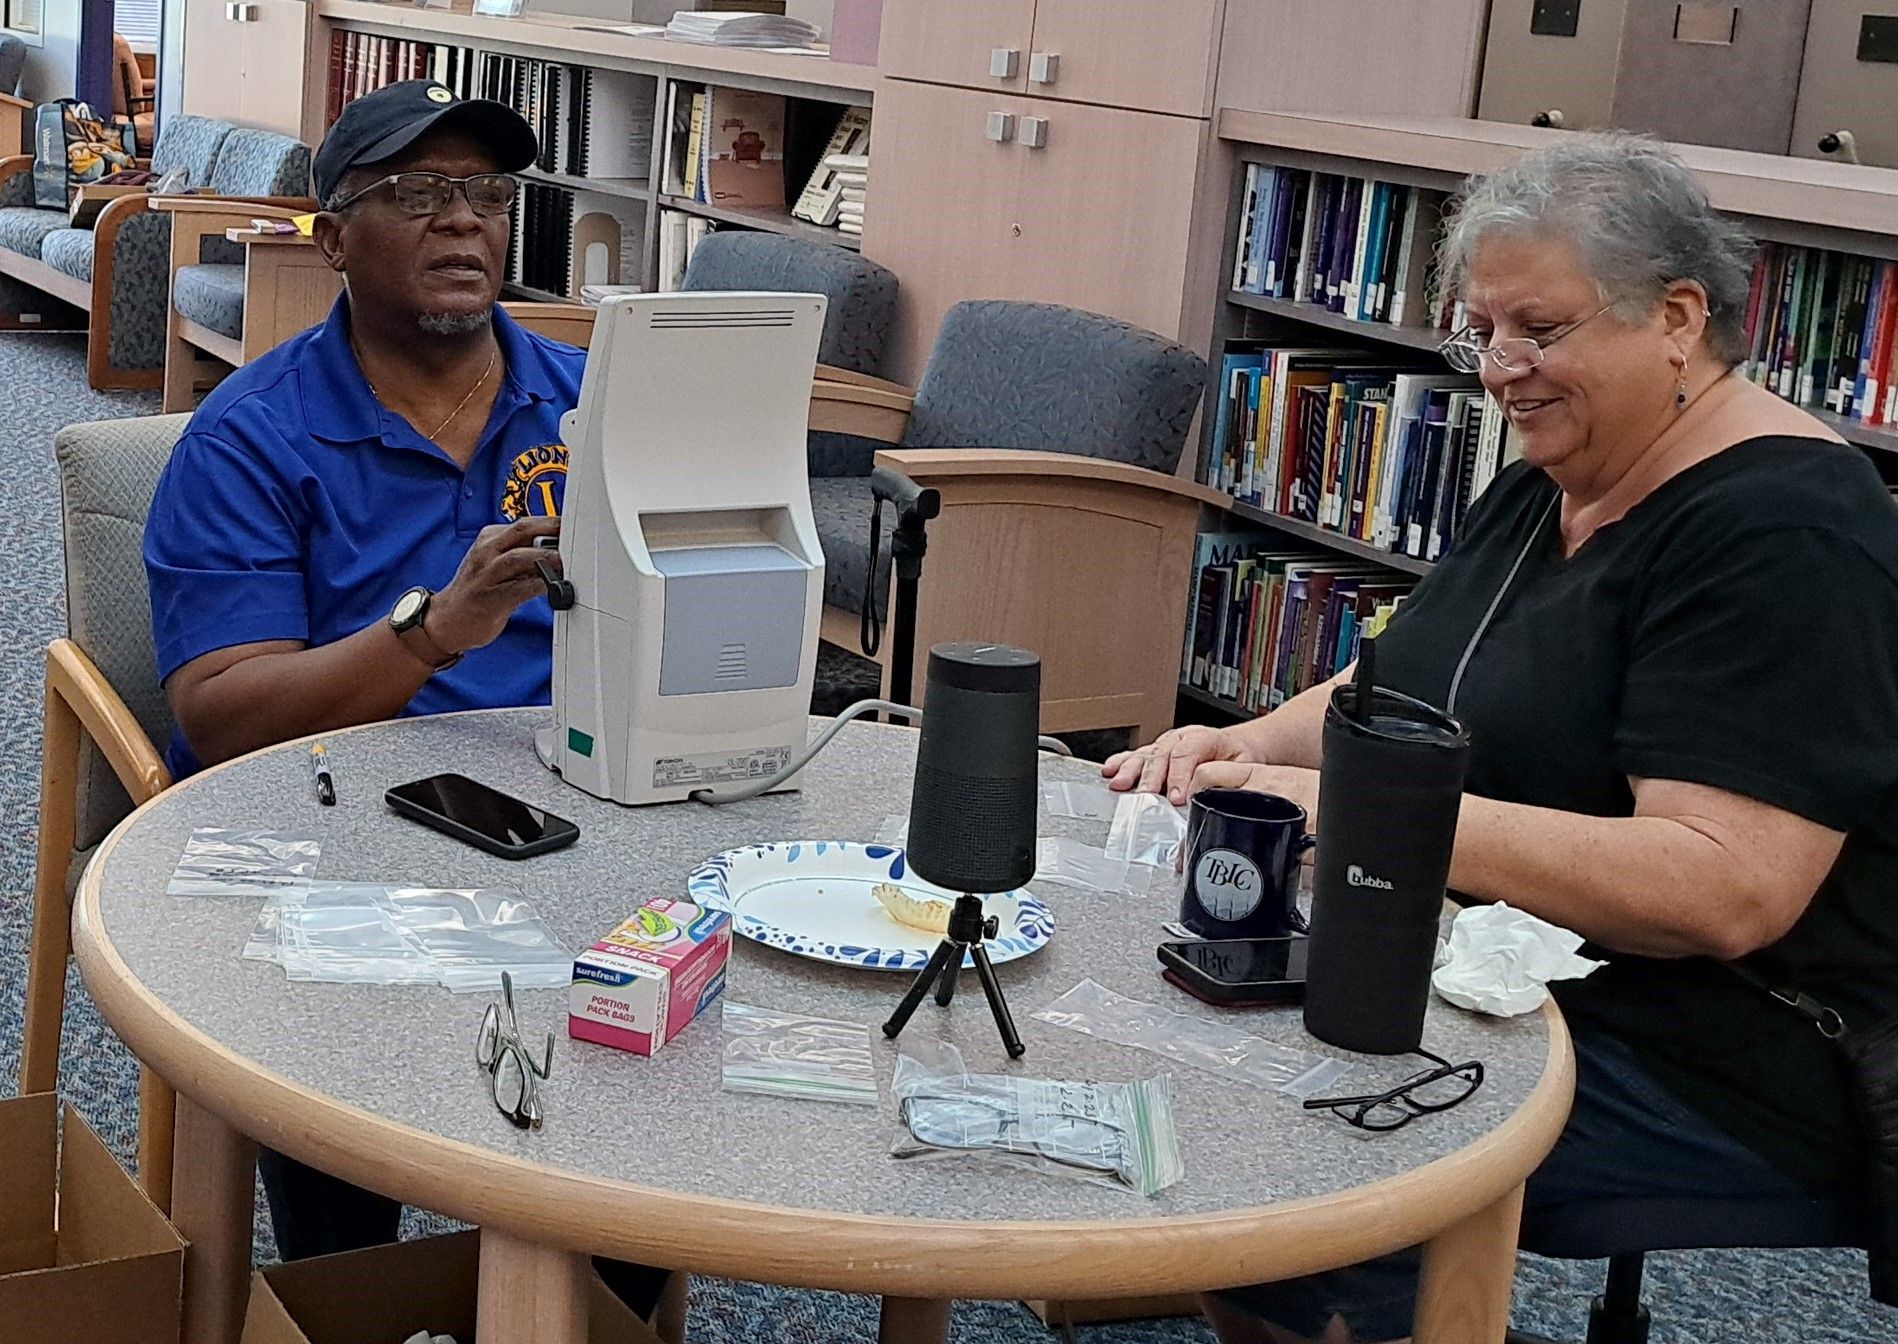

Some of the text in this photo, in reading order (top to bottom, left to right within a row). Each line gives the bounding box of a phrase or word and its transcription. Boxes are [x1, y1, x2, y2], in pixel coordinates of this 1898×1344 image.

[516, 447, 569, 474] LION
[604, 945, 663, 964] SNACK
[575, 966, 620, 983] surefresh
[583, 955, 658, 976] PORTION PACK
[591, 995, 630, 1012] PORTION
[586, 1004, 636, 1023] PACK BAGS
